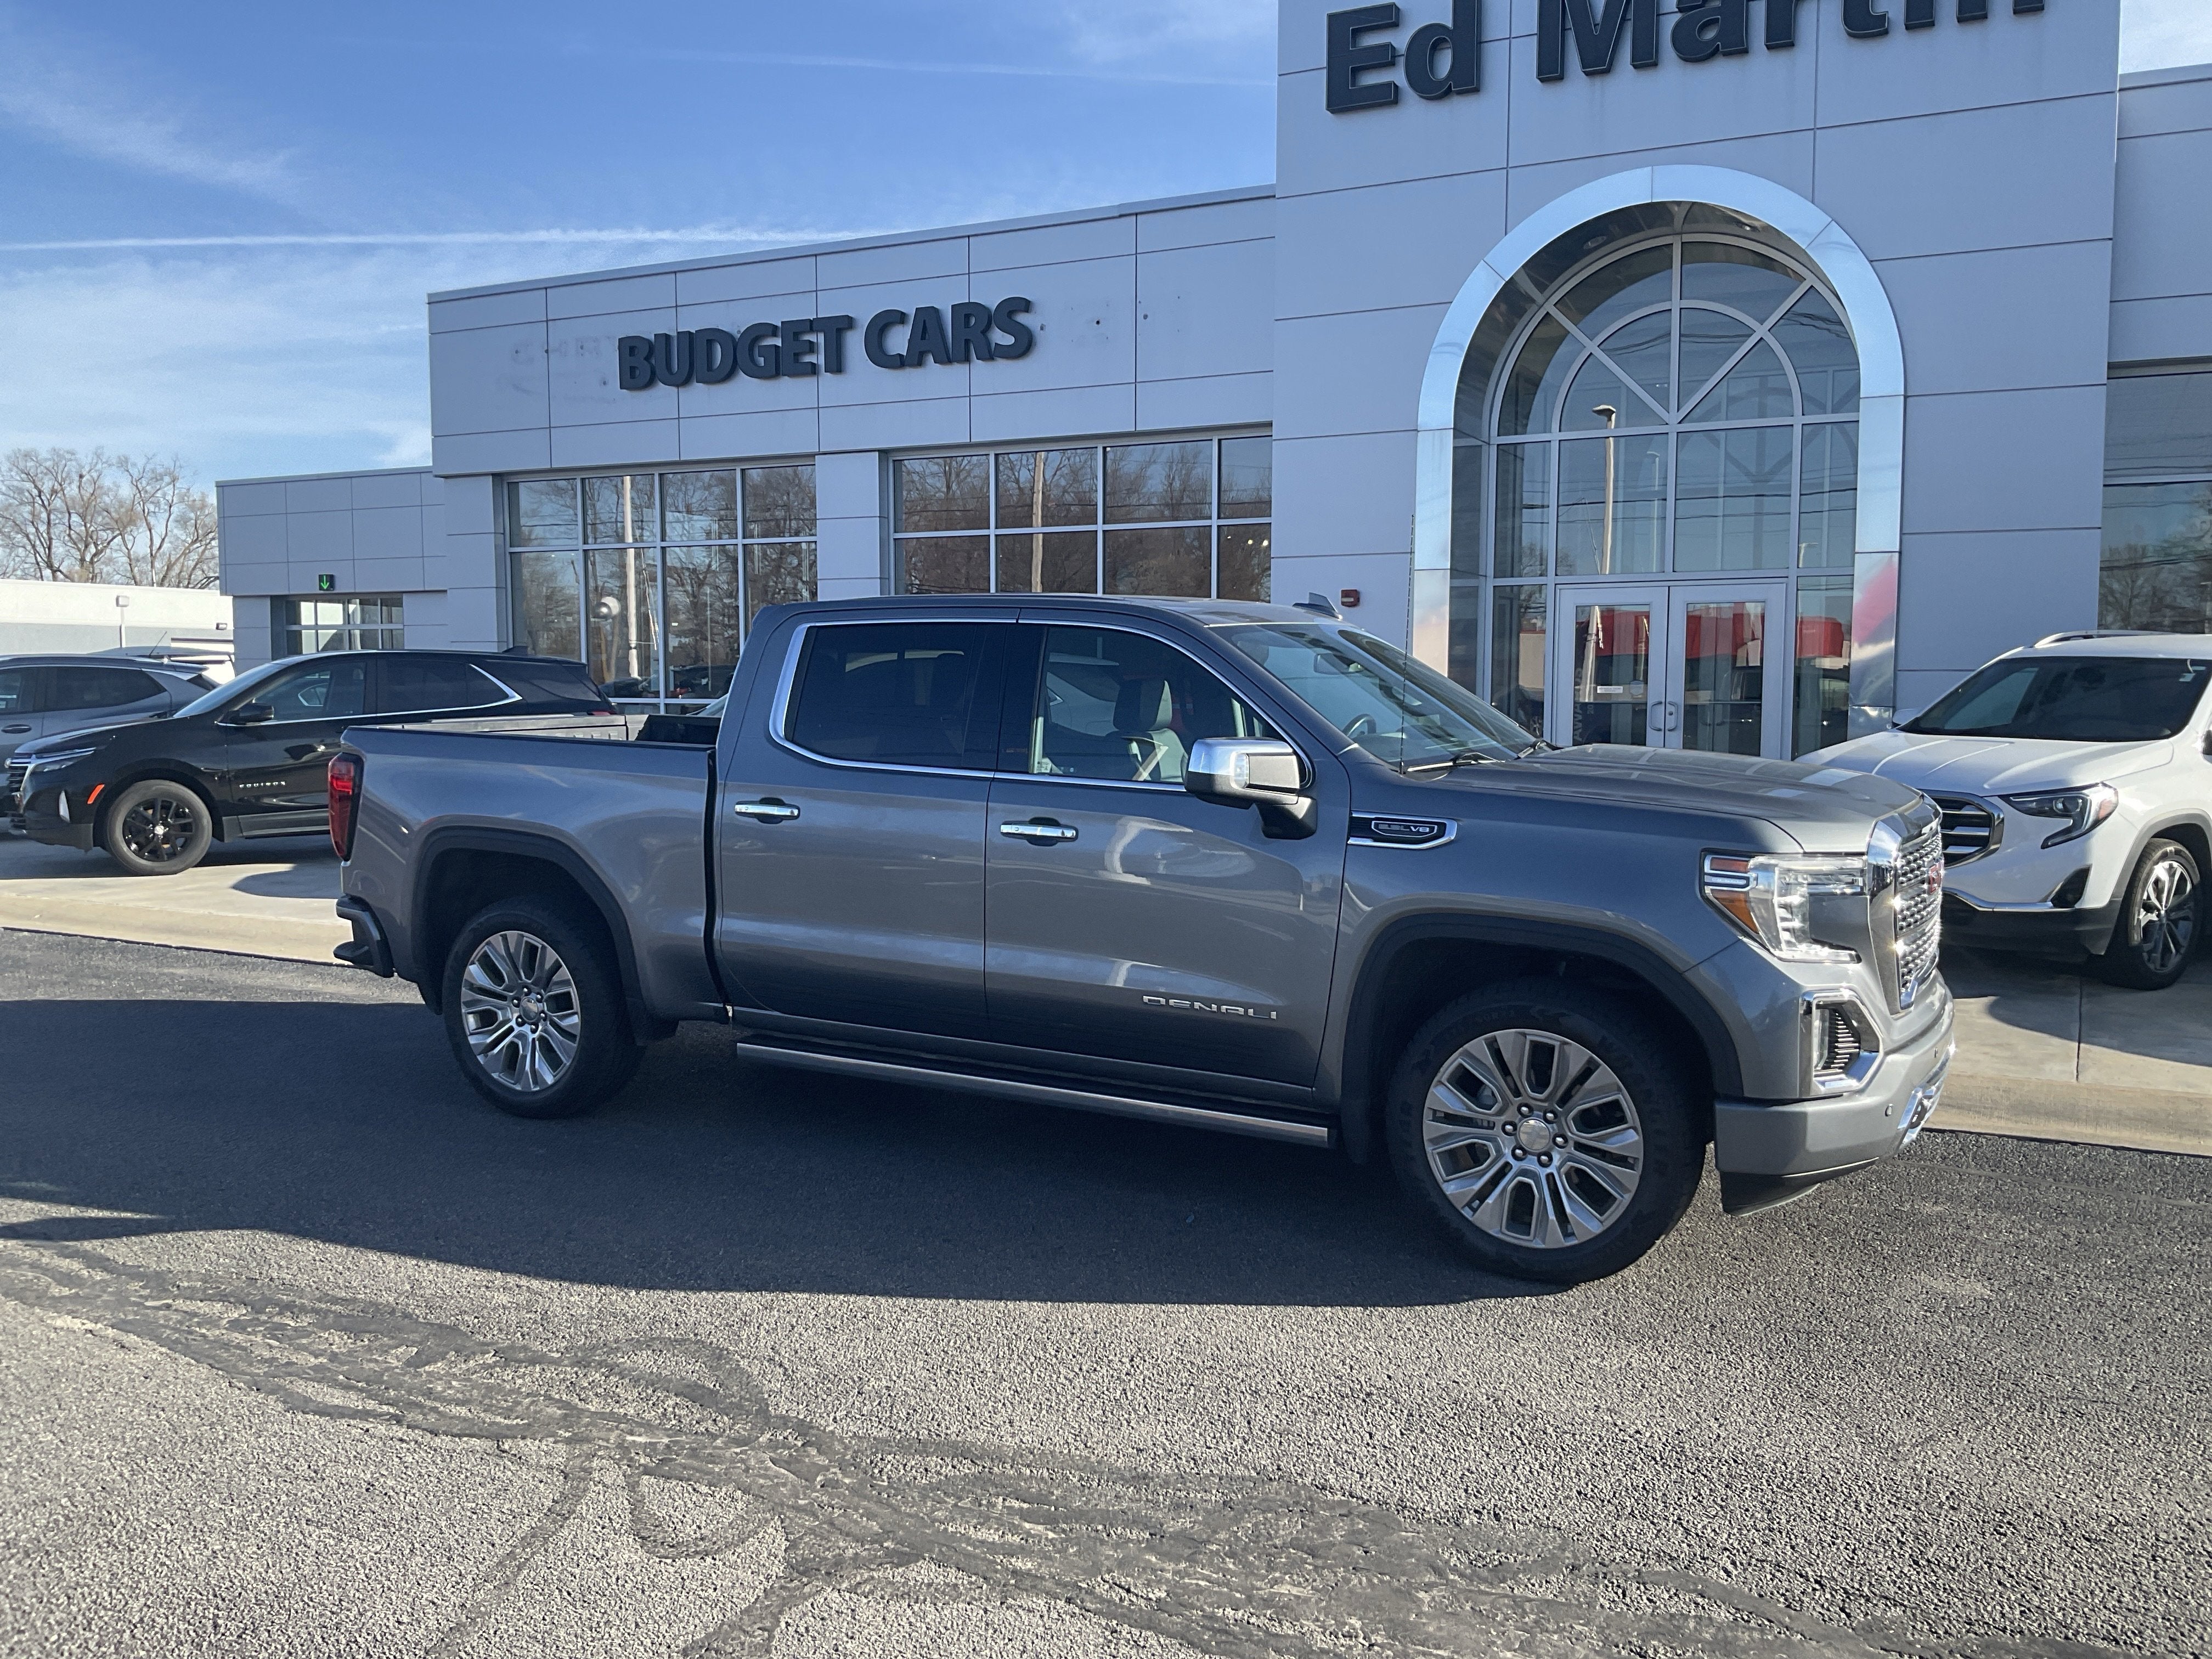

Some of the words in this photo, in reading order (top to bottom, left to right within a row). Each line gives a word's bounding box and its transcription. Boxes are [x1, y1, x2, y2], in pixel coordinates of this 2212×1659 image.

[1325, 0, 1481, 114] Ed
[1536, 0, 2045, 82] Mar
[618, 314, 853, 390] BUDGET
[864, 297, 1032, 368] CARS
[1143, 995, 1277, 1020] DENALI
